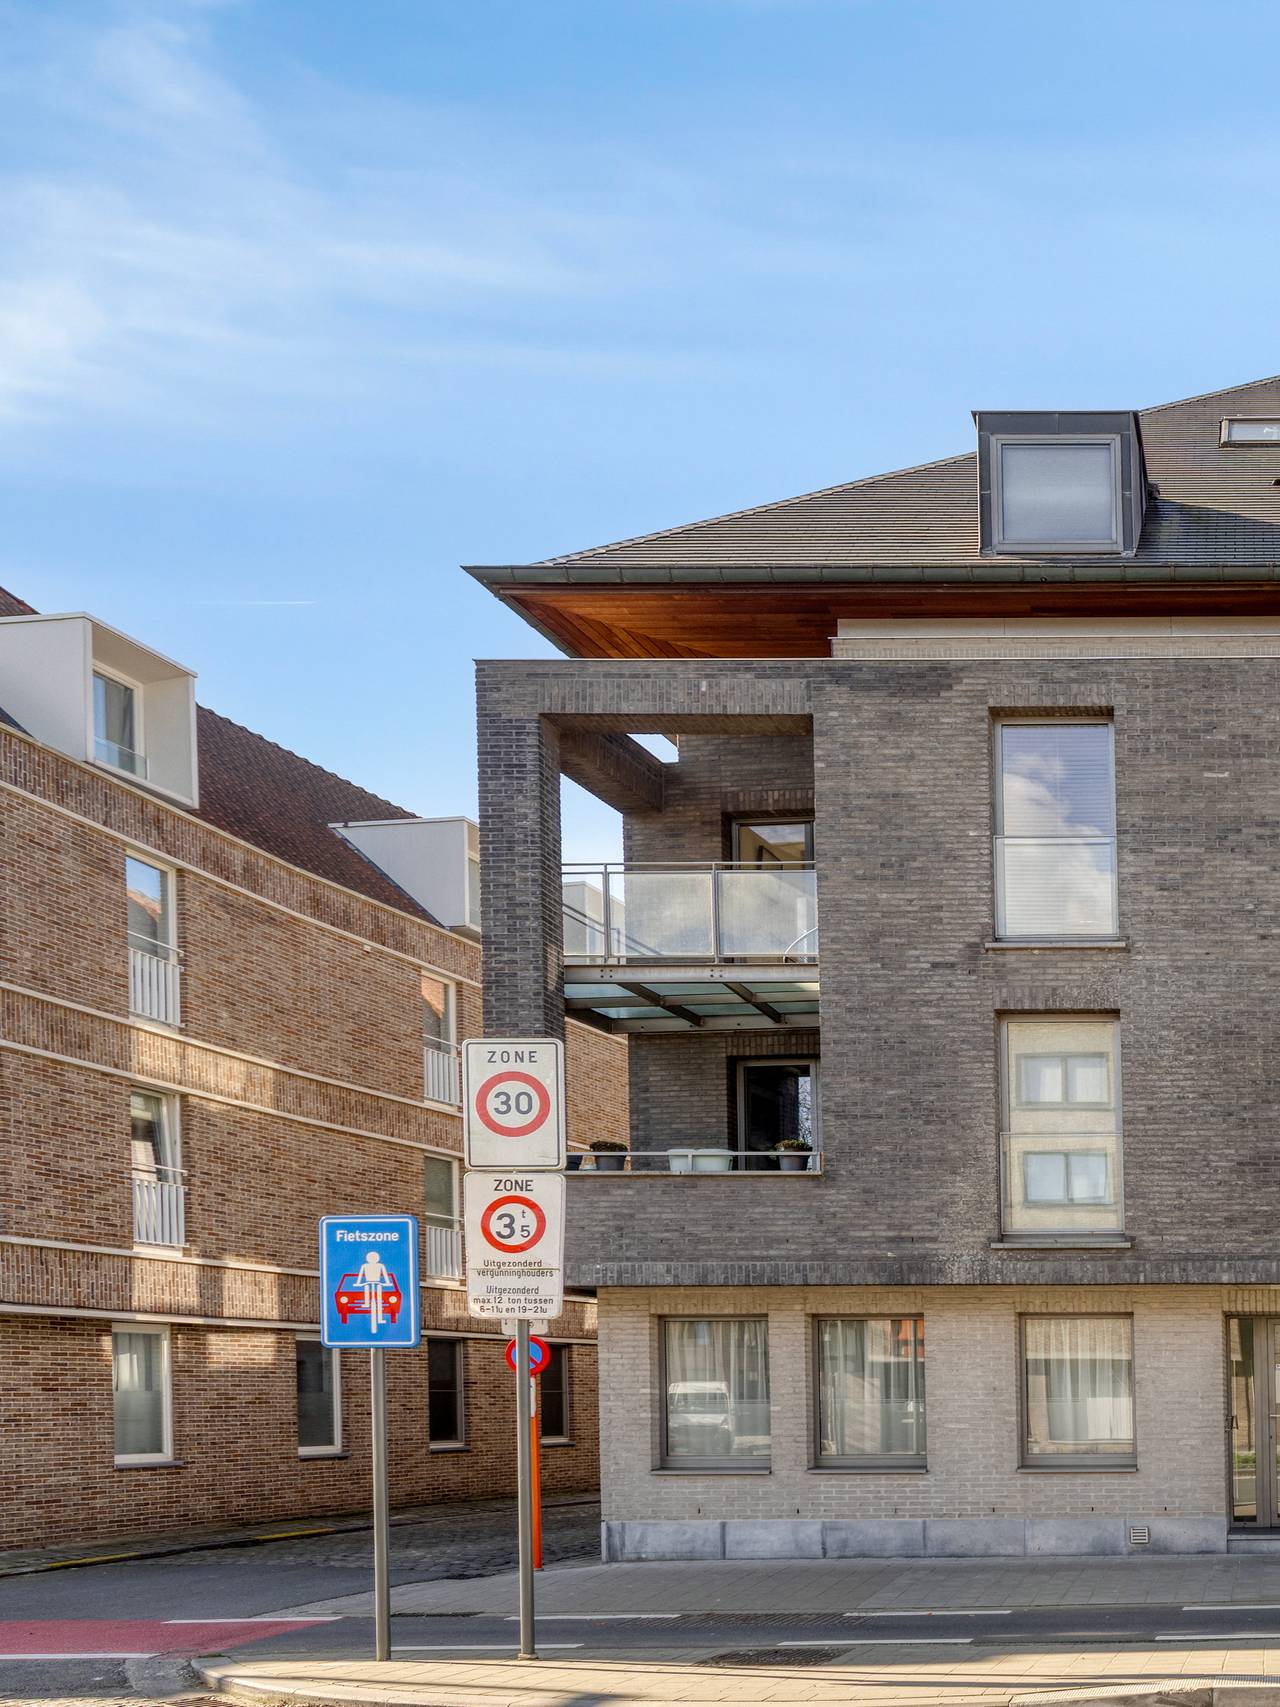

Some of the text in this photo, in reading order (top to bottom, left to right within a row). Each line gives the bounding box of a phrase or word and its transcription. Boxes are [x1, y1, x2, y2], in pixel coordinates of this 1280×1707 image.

[487, 1050, 538, 1063] ZONE
[493, 1091, 533, 1115] 30
[493, 1179, 534, 1192] ZONE
[335, 1229, 399, 1242] Fietszone
[483, 1259, 543, 1269] Uitgezonderd
[476, 1269, 554, 1278] vergunninghouders
[486, 1285, 540, 1294] Uitgezonderd
